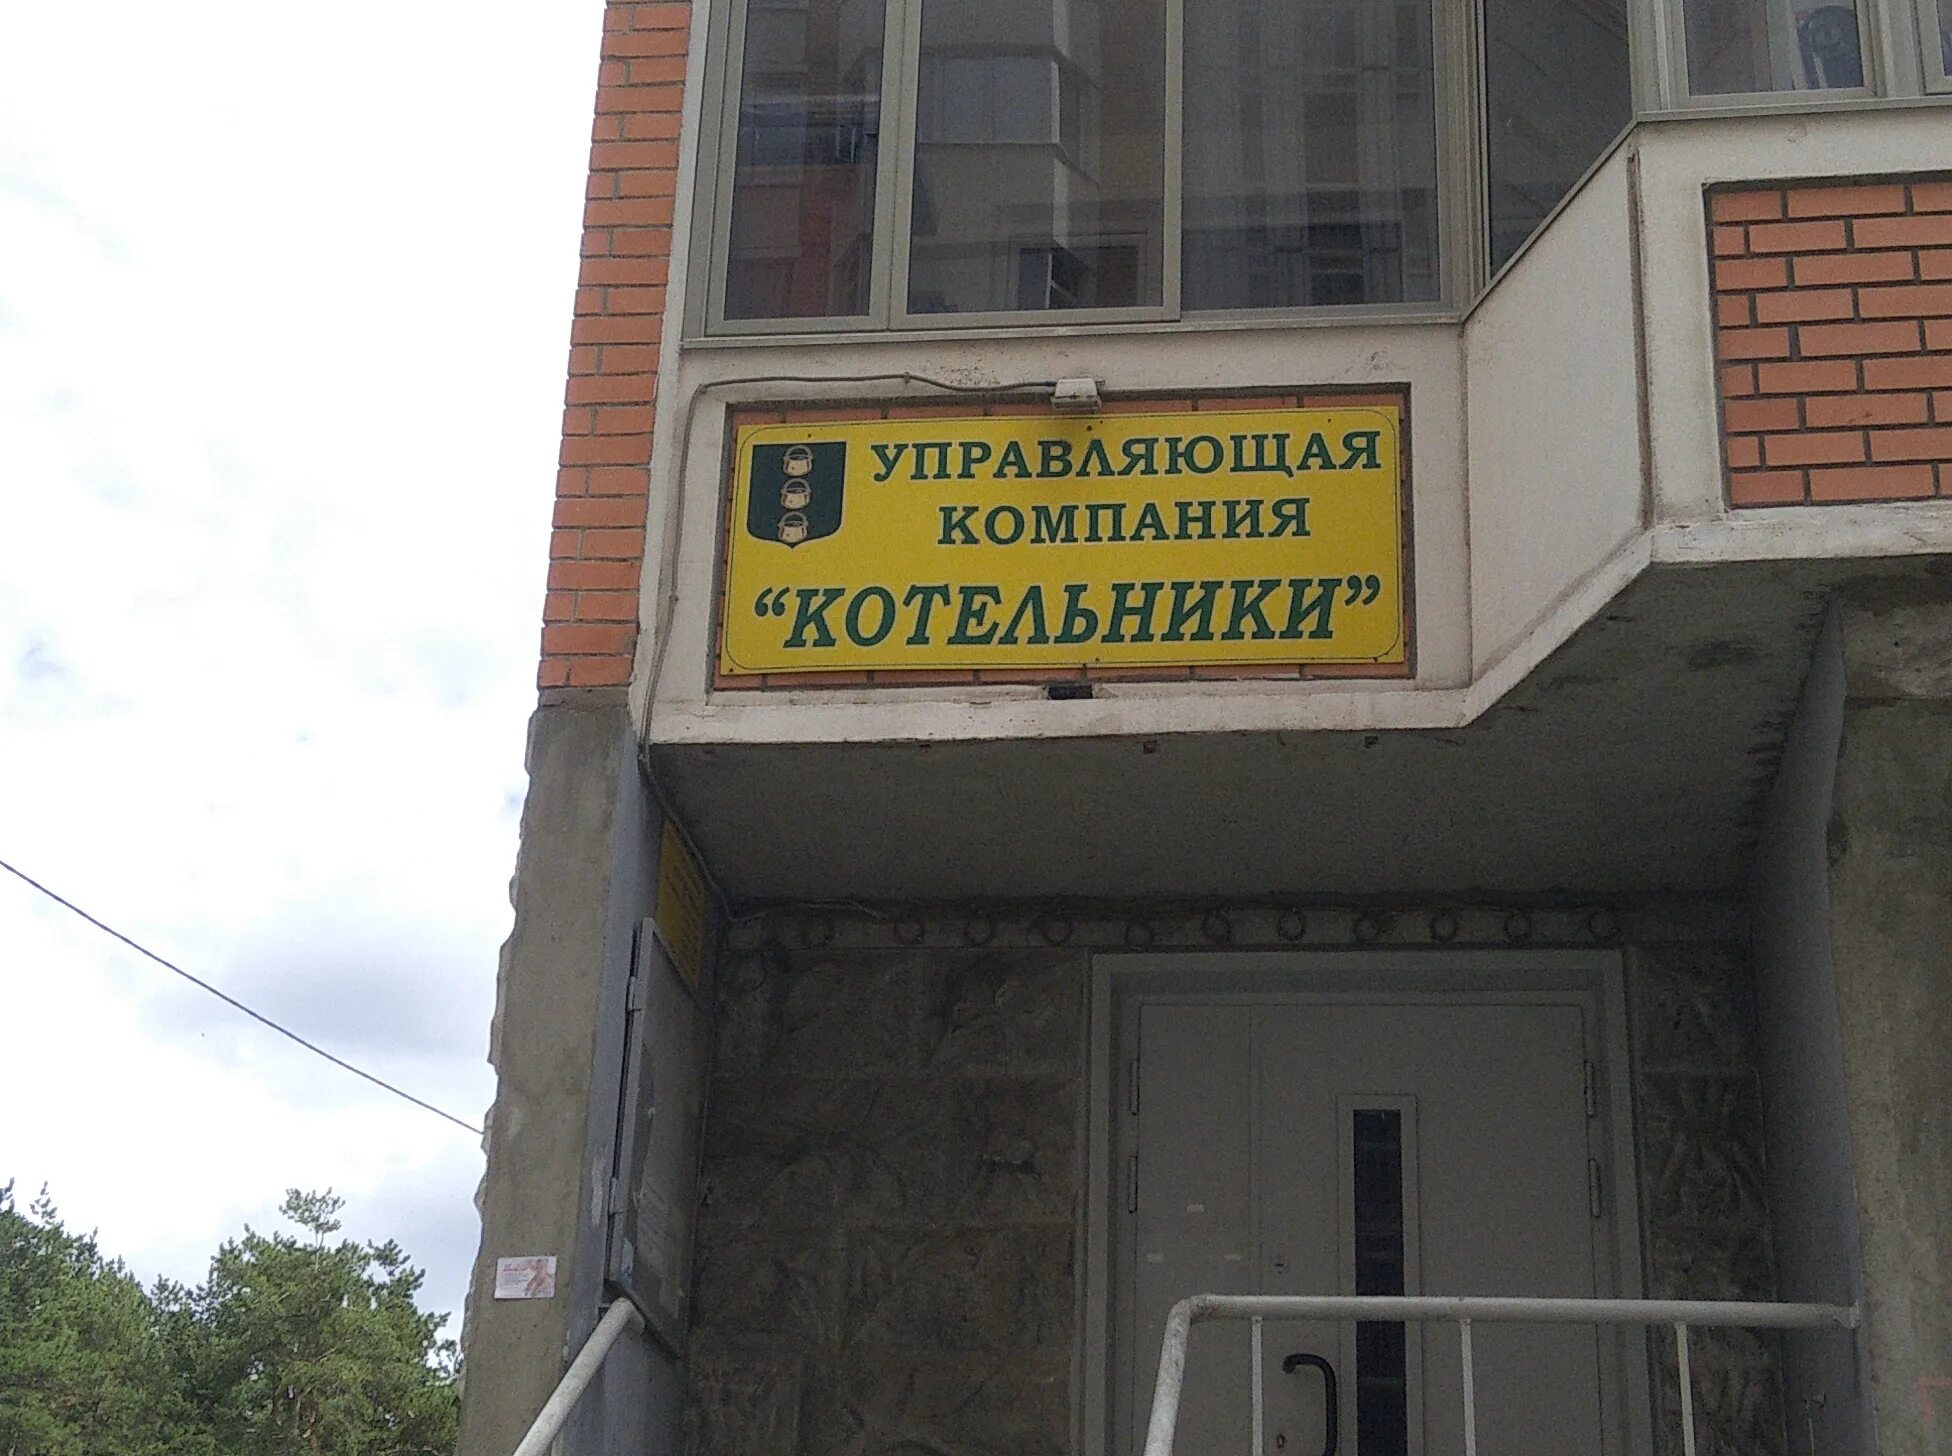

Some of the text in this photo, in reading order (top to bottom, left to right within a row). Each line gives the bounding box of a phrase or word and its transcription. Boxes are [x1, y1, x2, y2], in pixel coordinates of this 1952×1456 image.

[872, 431, 1382, 482] УПРАВЛЯЮЩАЯ
[938, 498, 1311, 546] КОМПАНИЯ
[754, 575, 1381, 649] “КОТЕЛЬНИКИ”
